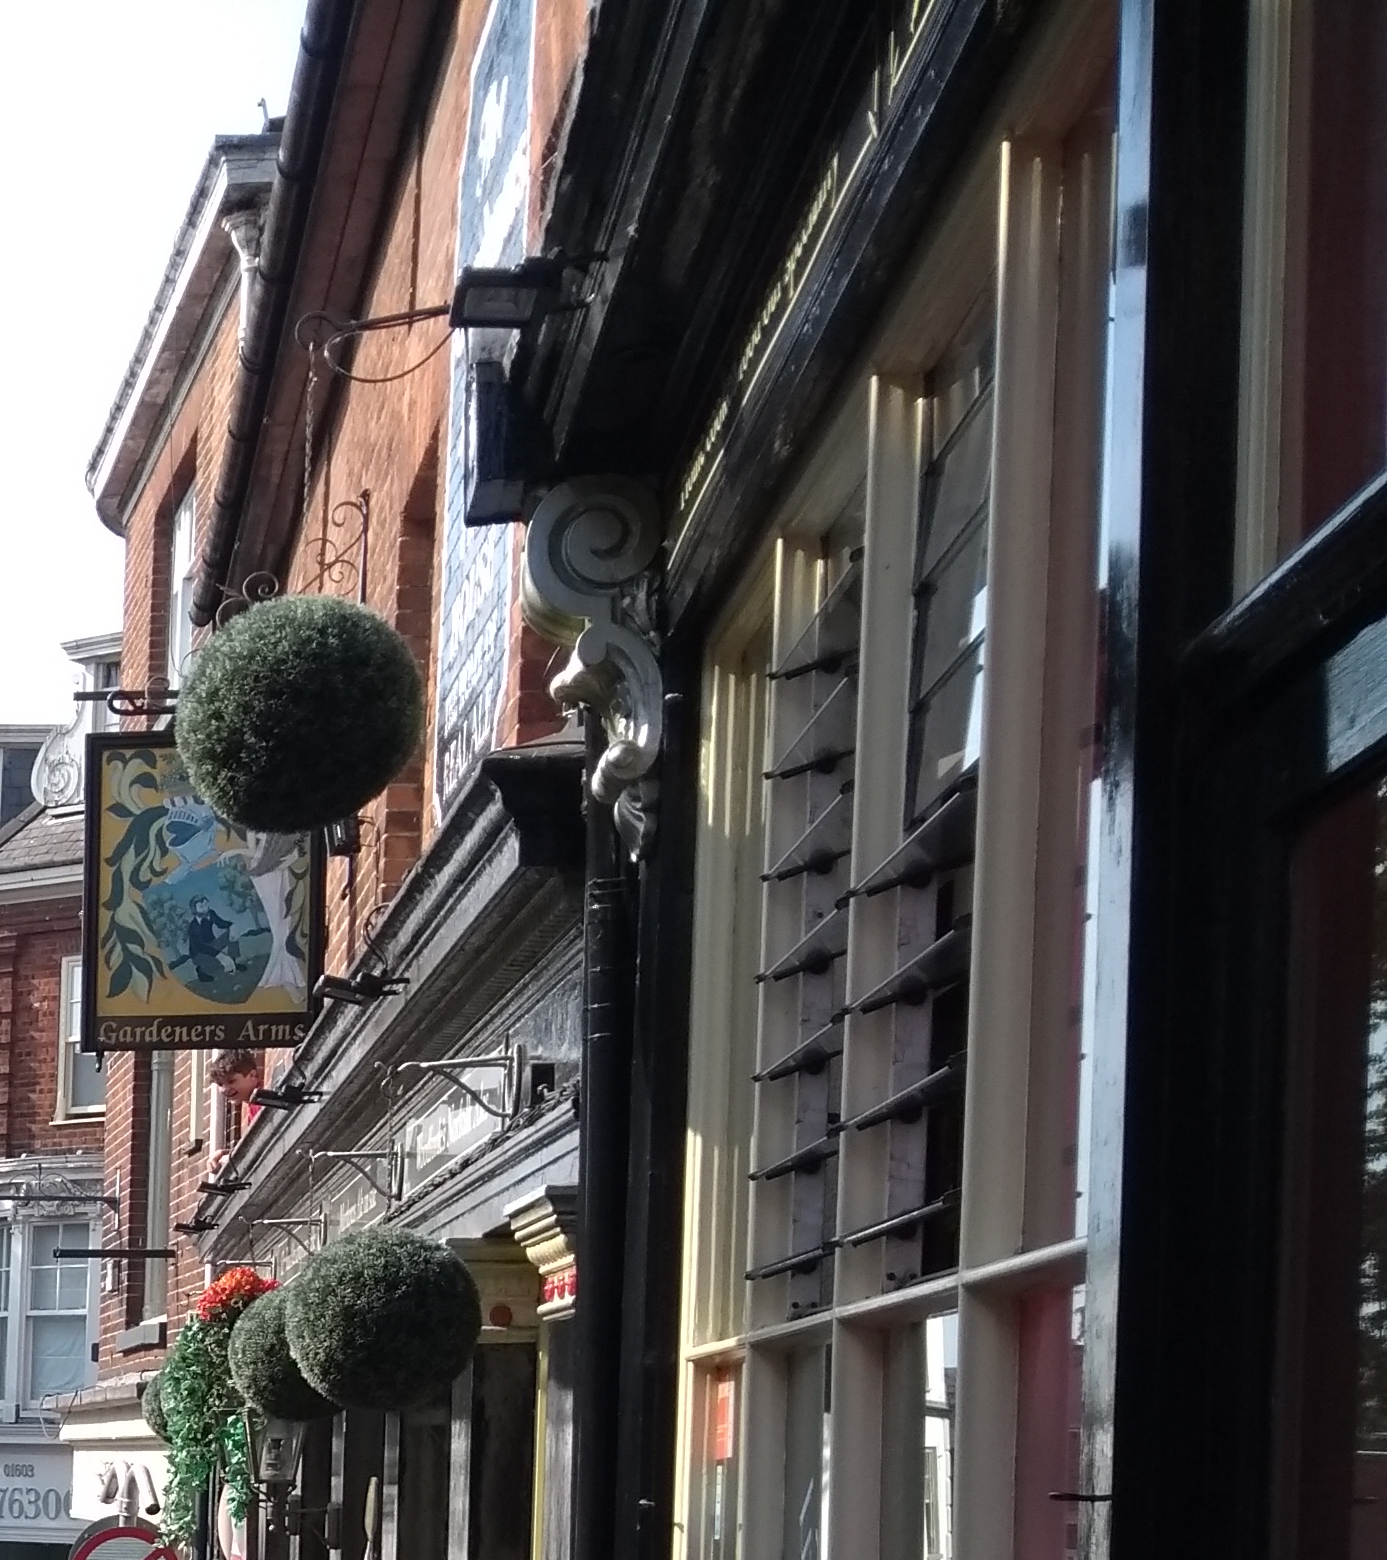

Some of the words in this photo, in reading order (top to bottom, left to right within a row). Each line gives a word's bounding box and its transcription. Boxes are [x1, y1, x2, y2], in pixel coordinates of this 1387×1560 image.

[98, 1017, 225, 1045] Gardeners
[237, 1018, 307, 1042] Arms
[3, 1463, 35, 1478] 01603
